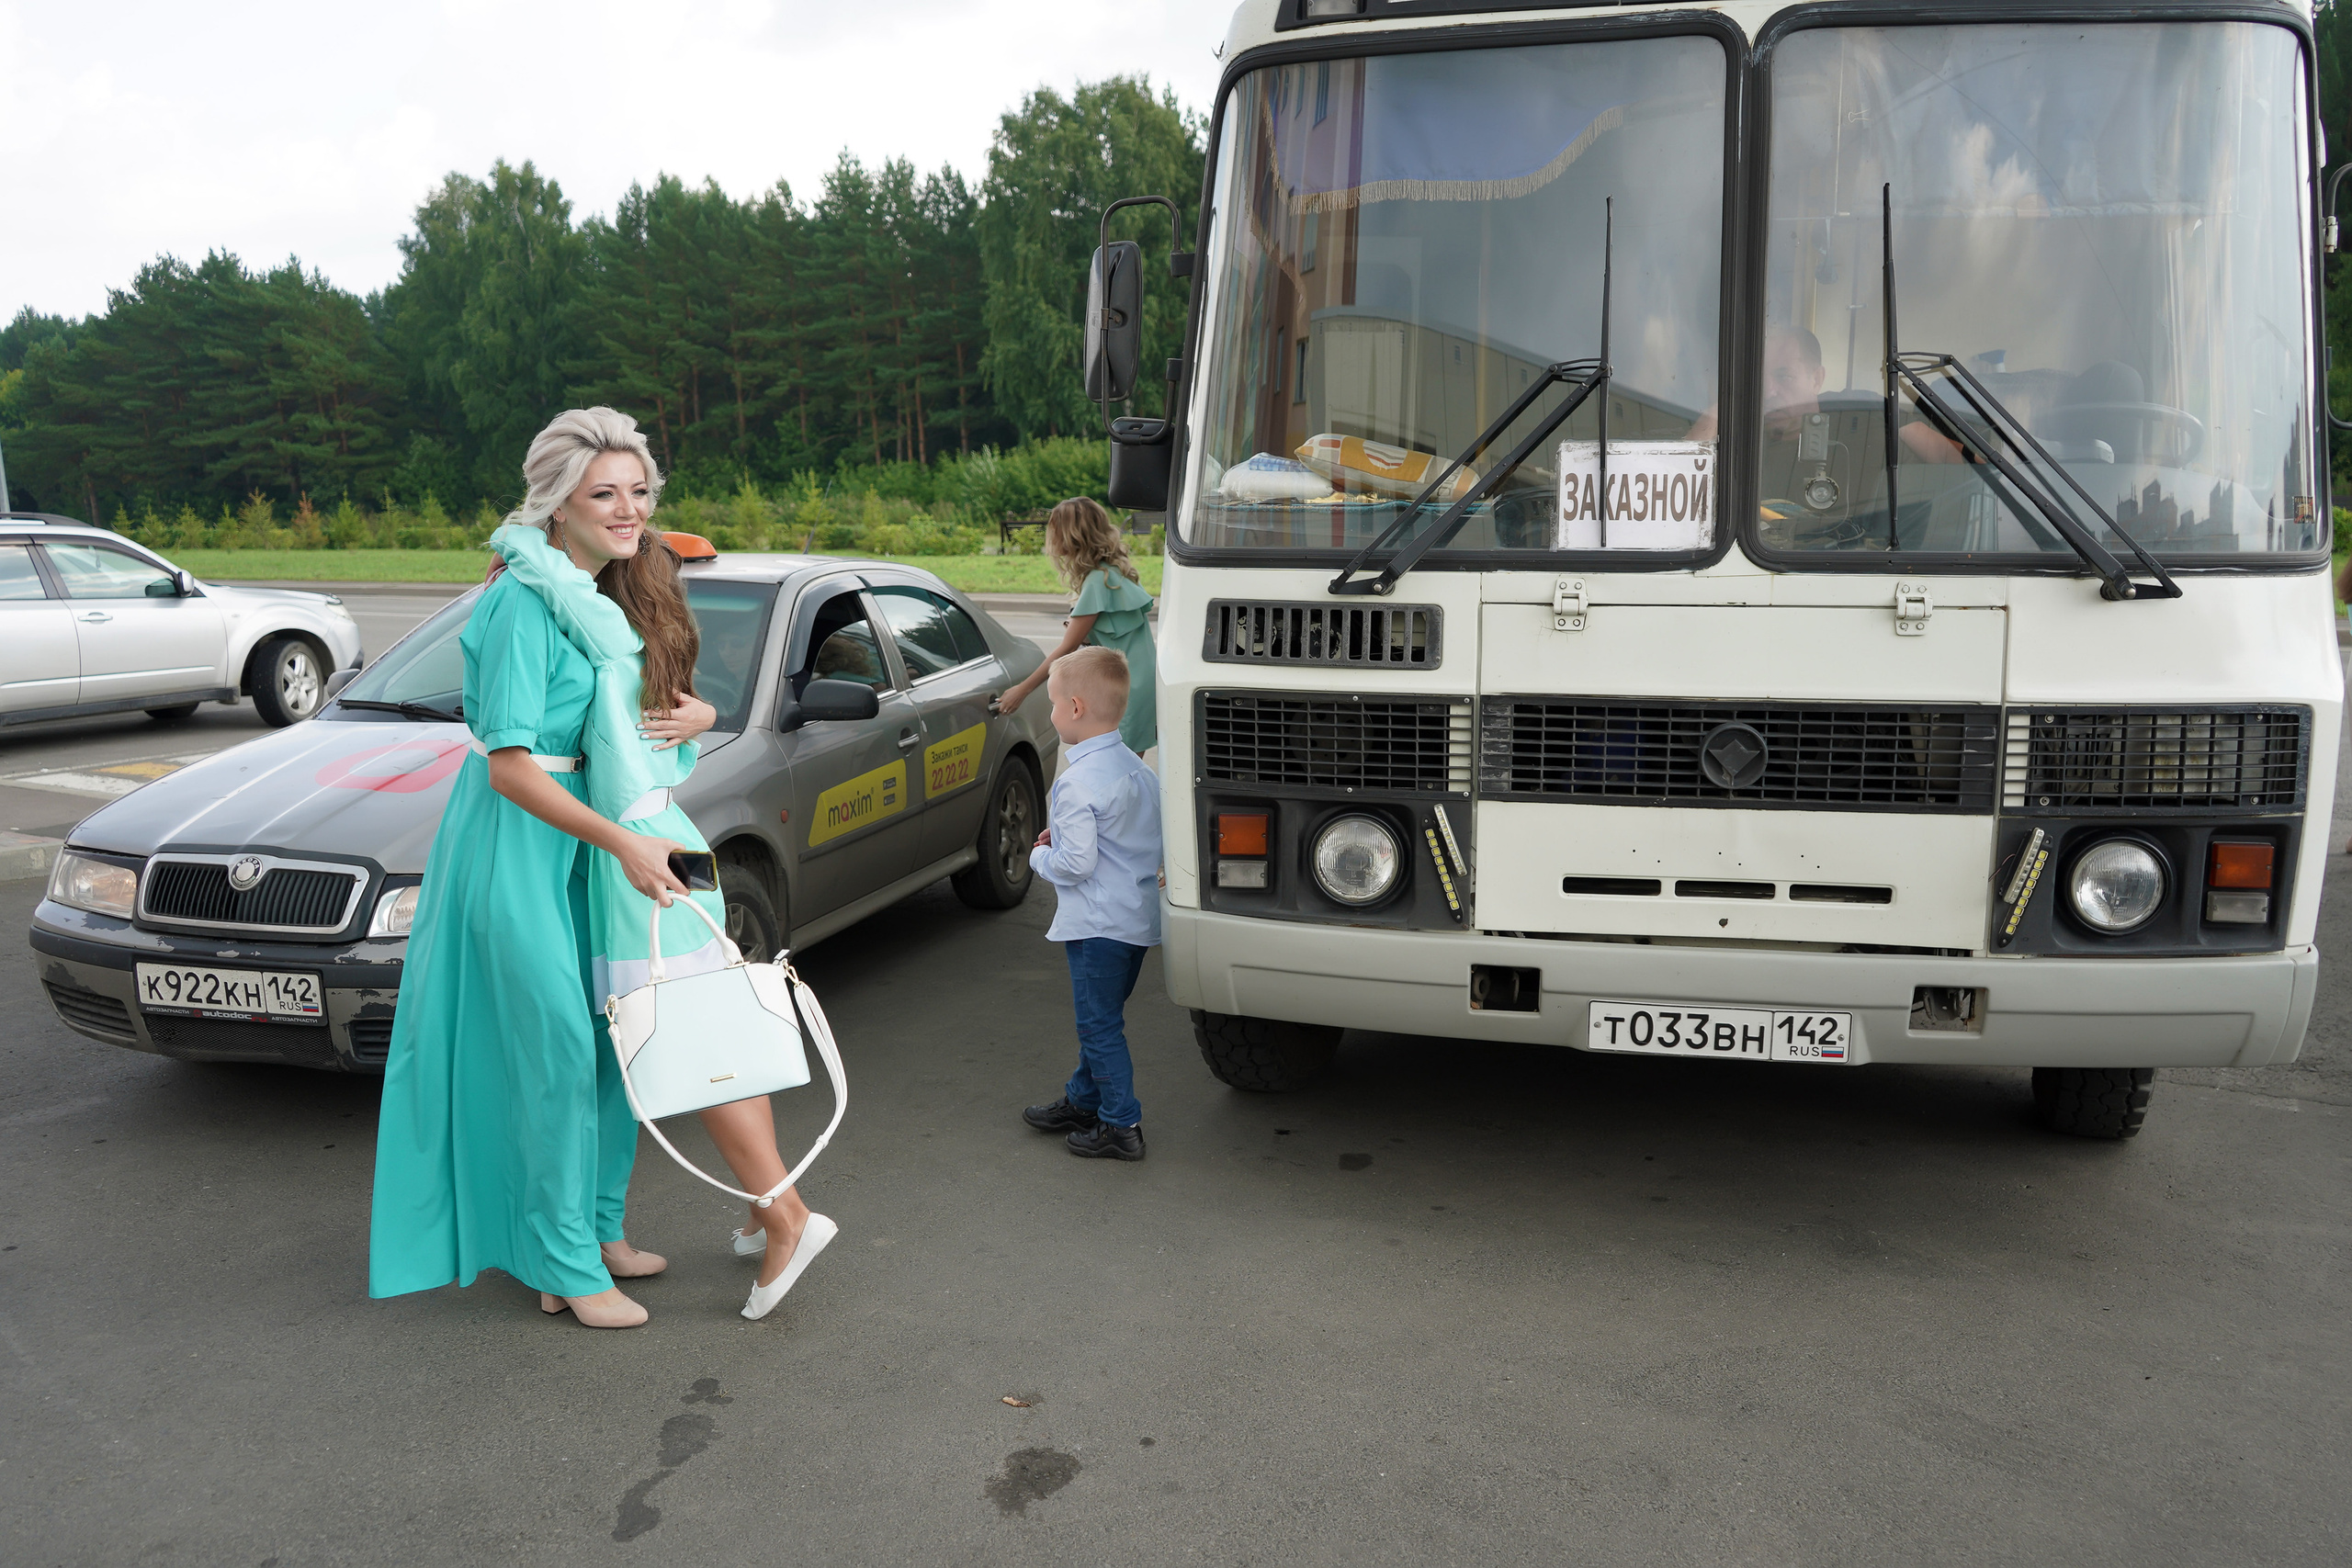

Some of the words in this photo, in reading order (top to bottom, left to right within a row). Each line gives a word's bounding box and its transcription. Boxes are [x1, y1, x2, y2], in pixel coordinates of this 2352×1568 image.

[1563, 458, 1708, 523] ЗАКАЗНОЙ
[932, 768, 944, 791] 22
[945, 762, 956, 786] 22
[958, 758, 968, 780] 22
[828, 790, 872, 828] maxim
[267, 976, 313, 1002] 142
[279, 1000, 302, 1011] RUS
[1777, 1015, 1838, 1045] 142
[1790, 1045, 1820, 1056] RUS
